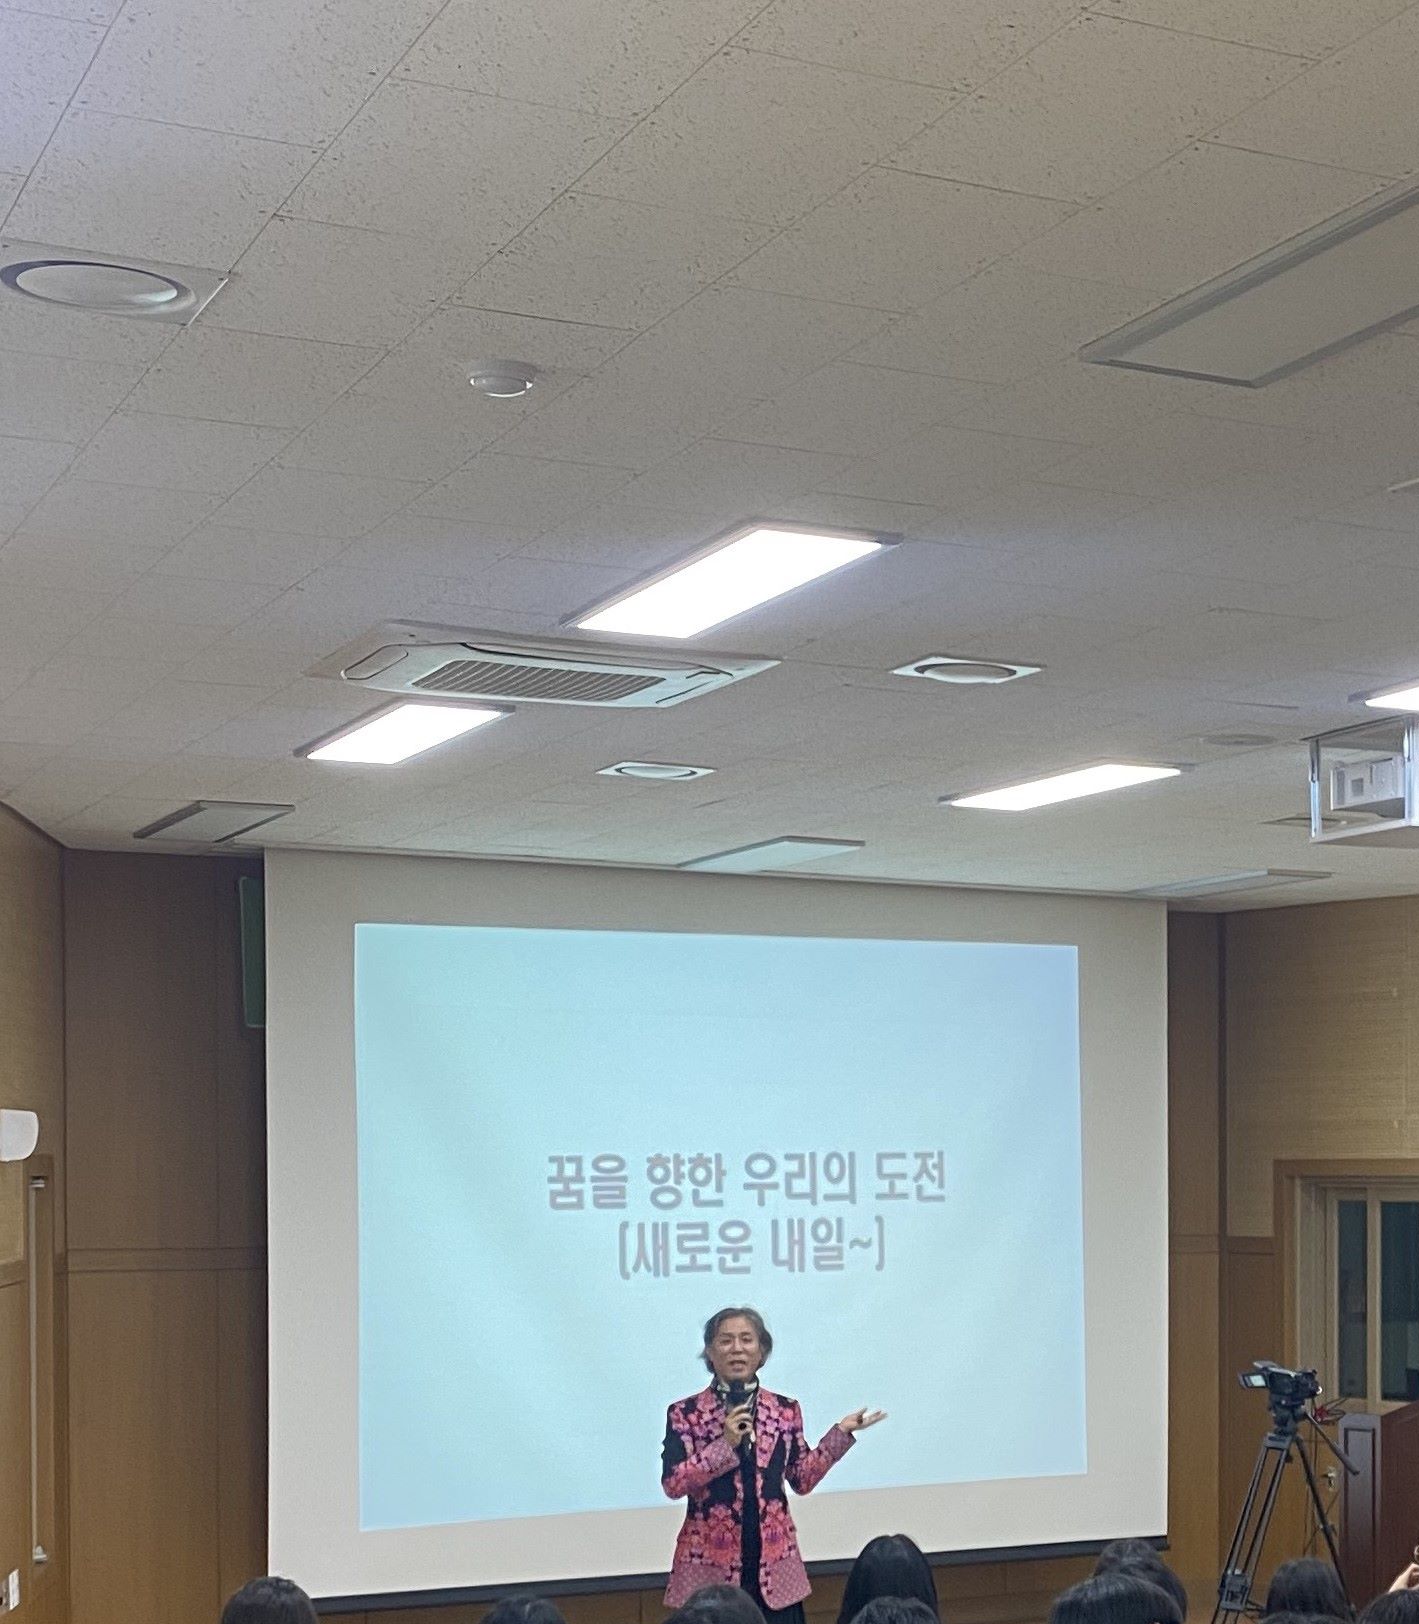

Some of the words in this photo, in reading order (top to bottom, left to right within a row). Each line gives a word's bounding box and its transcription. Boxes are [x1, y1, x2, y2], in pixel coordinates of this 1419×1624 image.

[547, 1153, 629, 1211] 꿈을
[646, 1152, 727, 1210] 향한
[742, 1150, 858, 1208] 우리의
[875, 1149, 946, 1203] 도전
